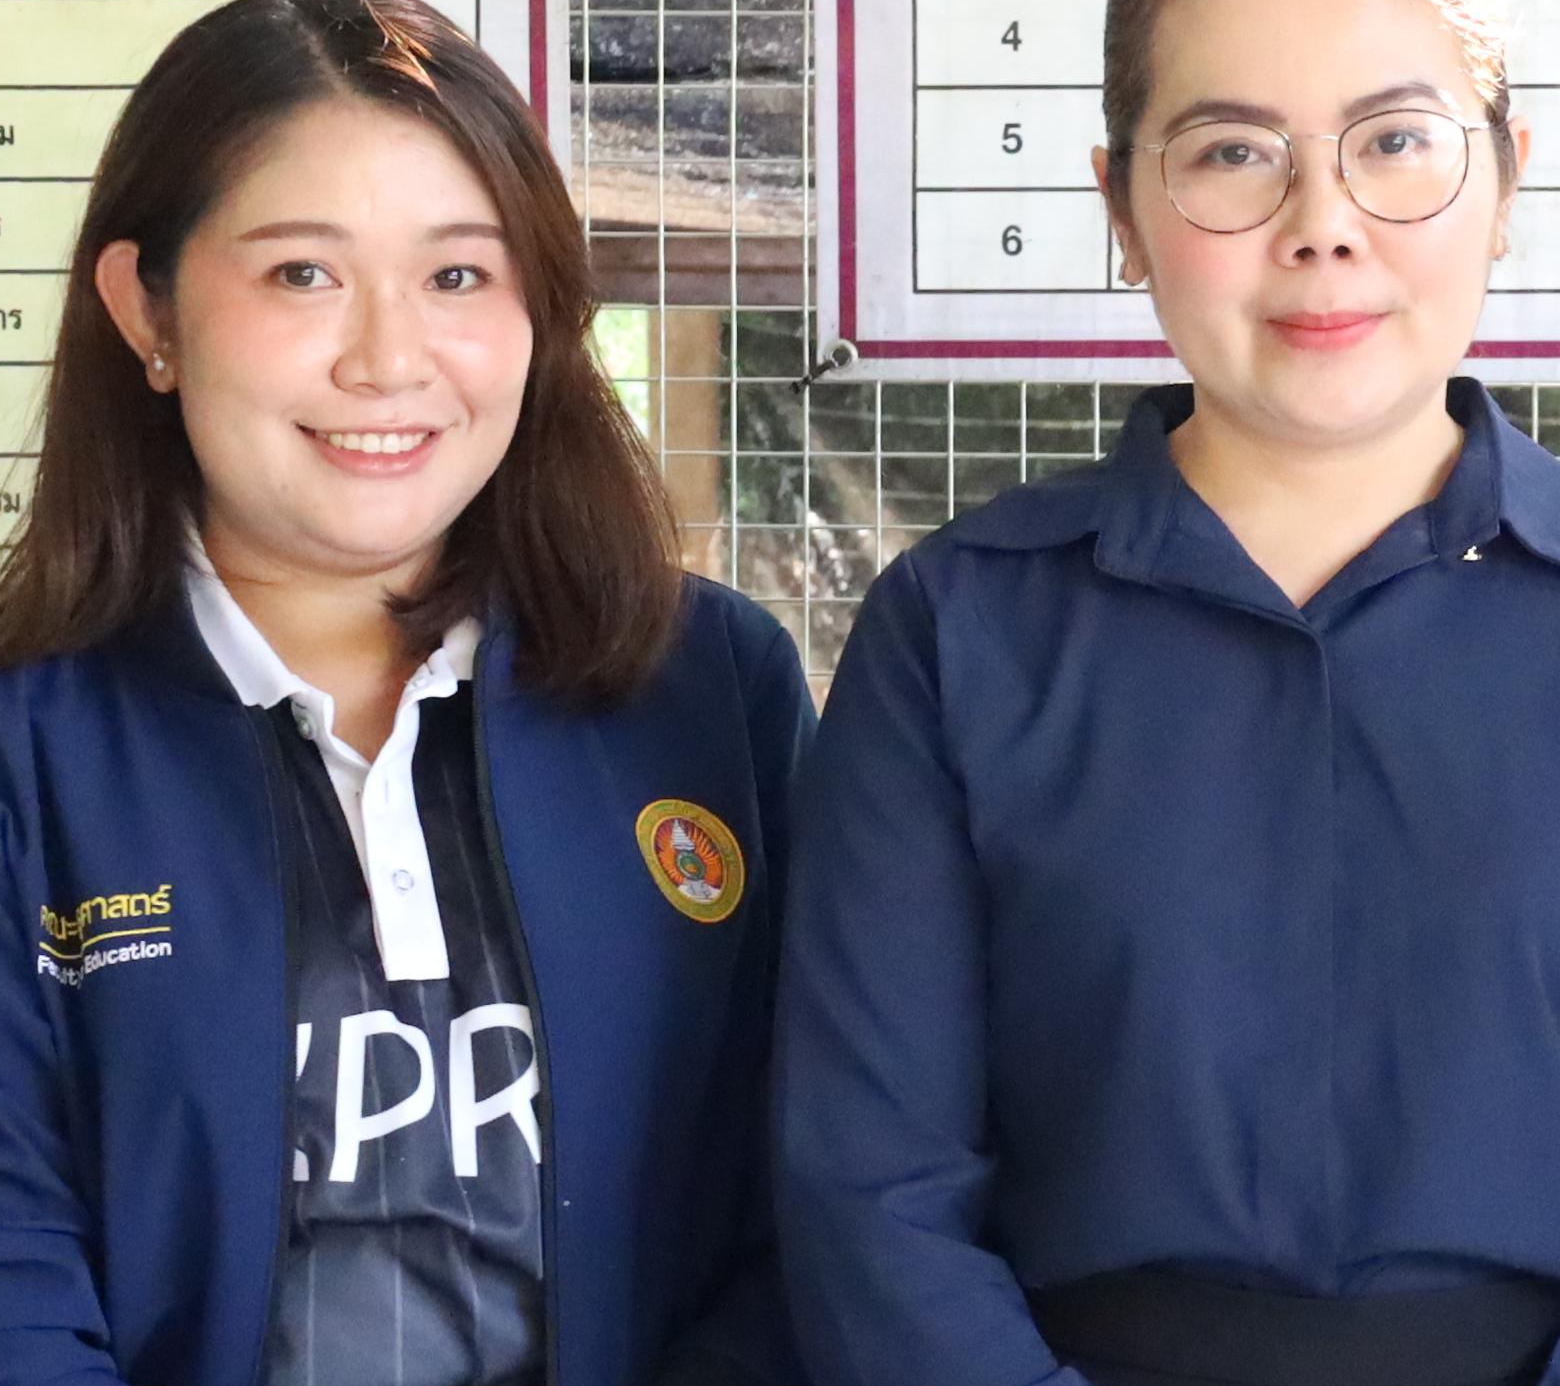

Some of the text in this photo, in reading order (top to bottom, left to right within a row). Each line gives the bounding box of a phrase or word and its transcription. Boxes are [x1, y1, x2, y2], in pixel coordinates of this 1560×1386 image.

[1000, 20, 1023, 52] 4
[1001, 122, 1024, 155] 5
[1001, 224, 1024, 257] 6
[83, 939, 172, 974] Education
